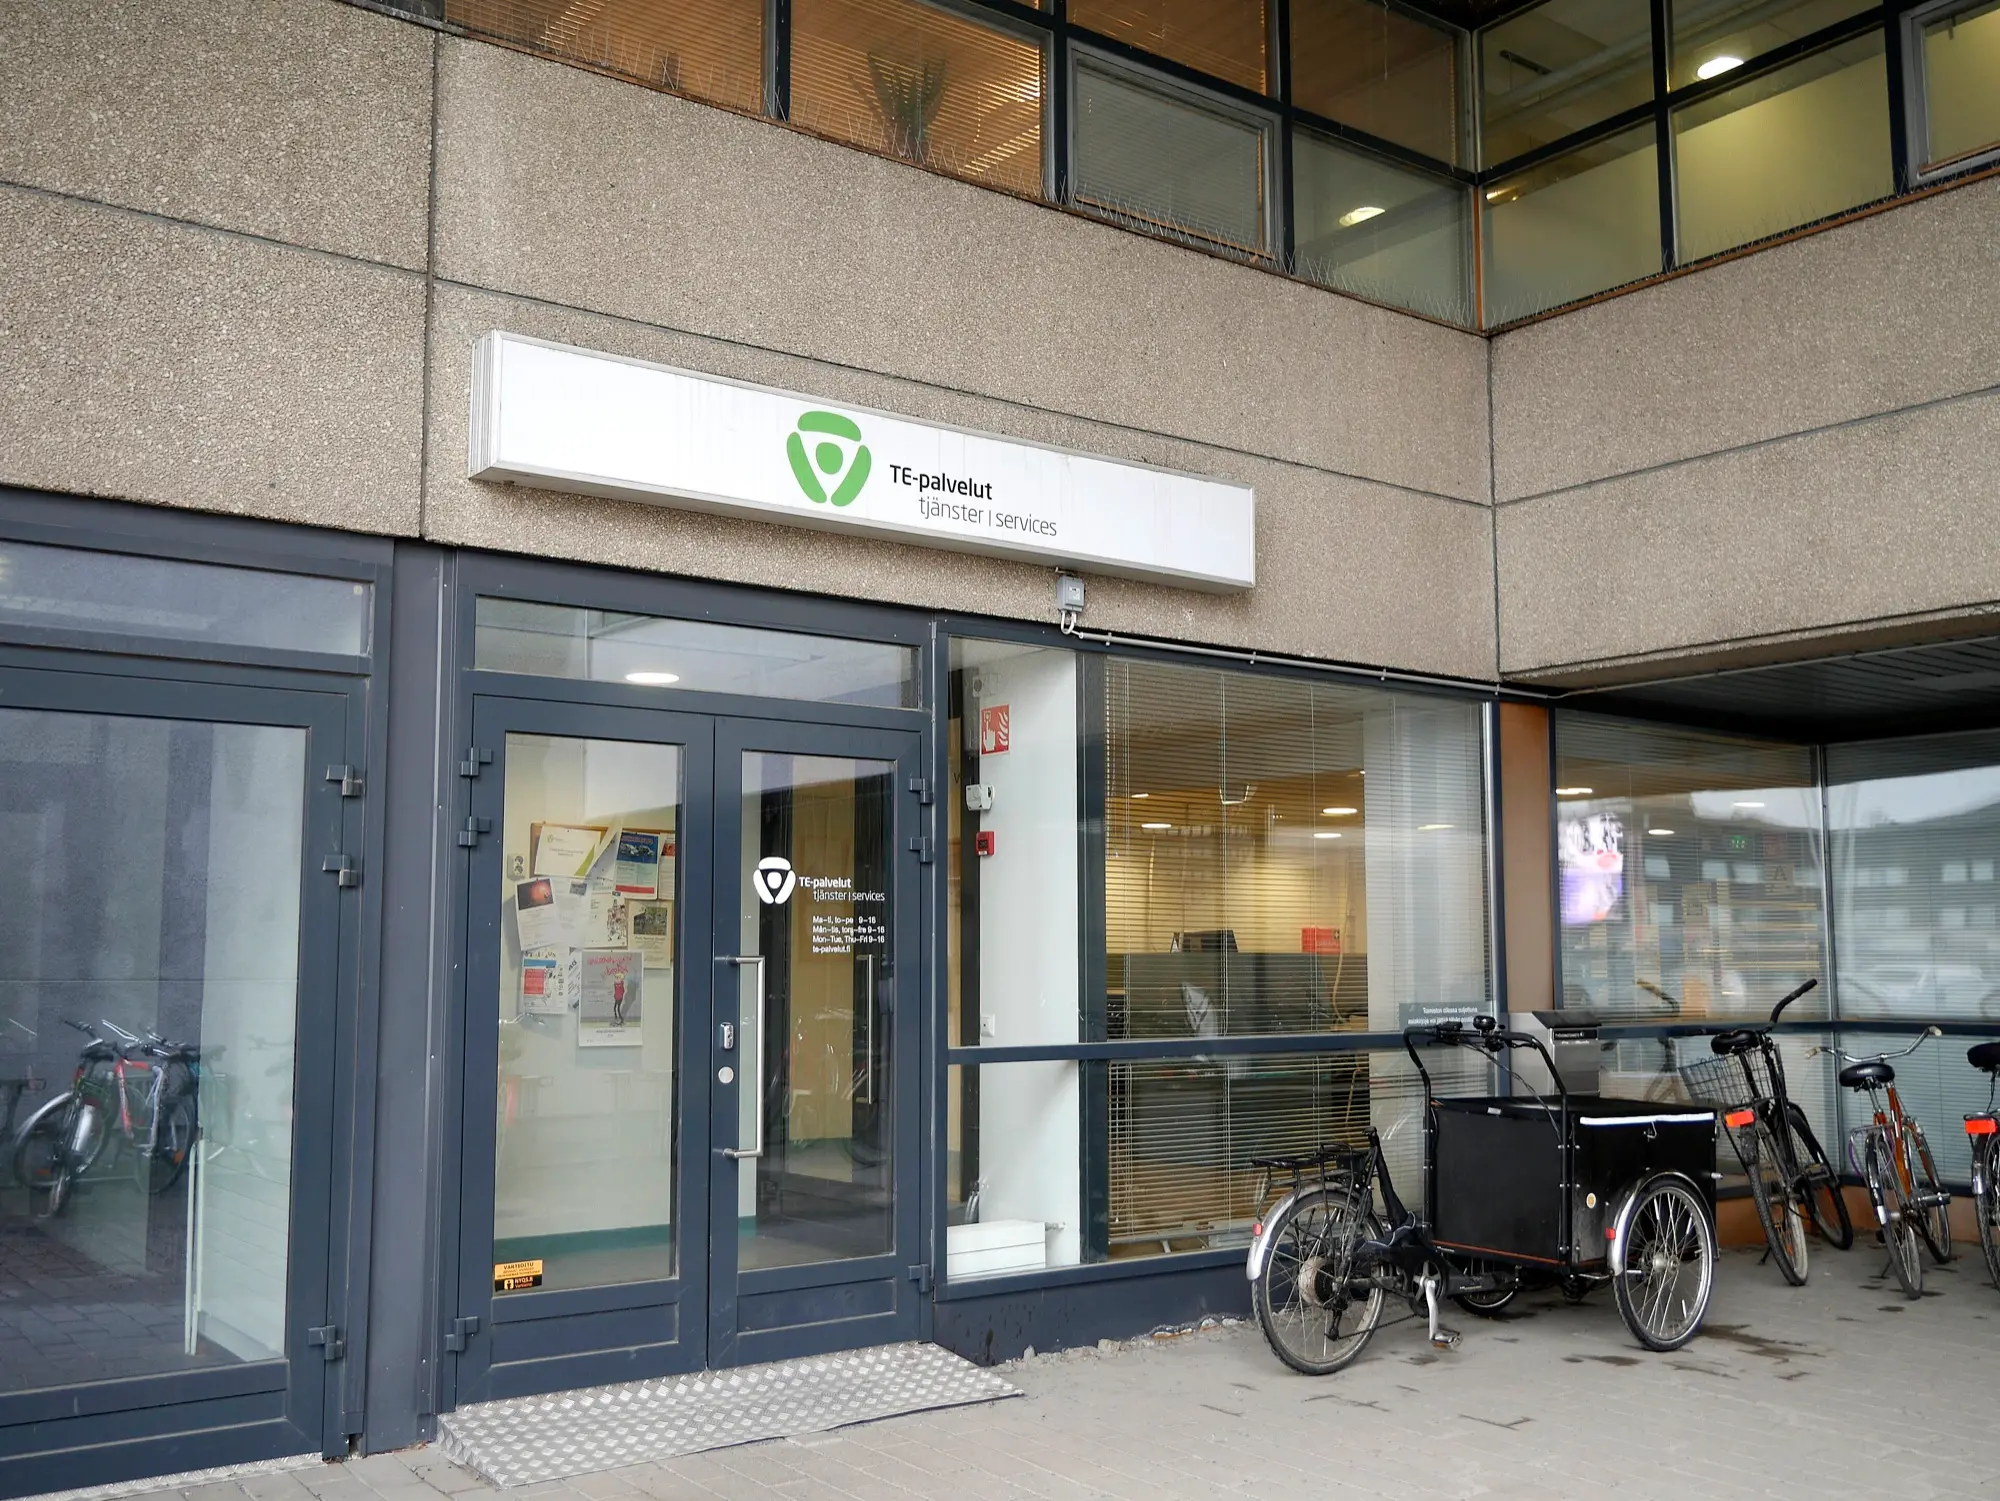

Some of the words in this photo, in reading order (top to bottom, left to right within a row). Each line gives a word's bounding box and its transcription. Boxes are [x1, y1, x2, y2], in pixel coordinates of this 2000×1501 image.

[889, 464, 993, 500] TE-palvelut
[918, 495, 984, 524] tjänster
[995, 513, 1057, 537] services
[798, 876, 852, 889] TE-palvelut
[813, 889, 848, 903] tjänster
[852, 890, 886, 902] services
[812, 945, 851, 954] te-palvelut.fi
